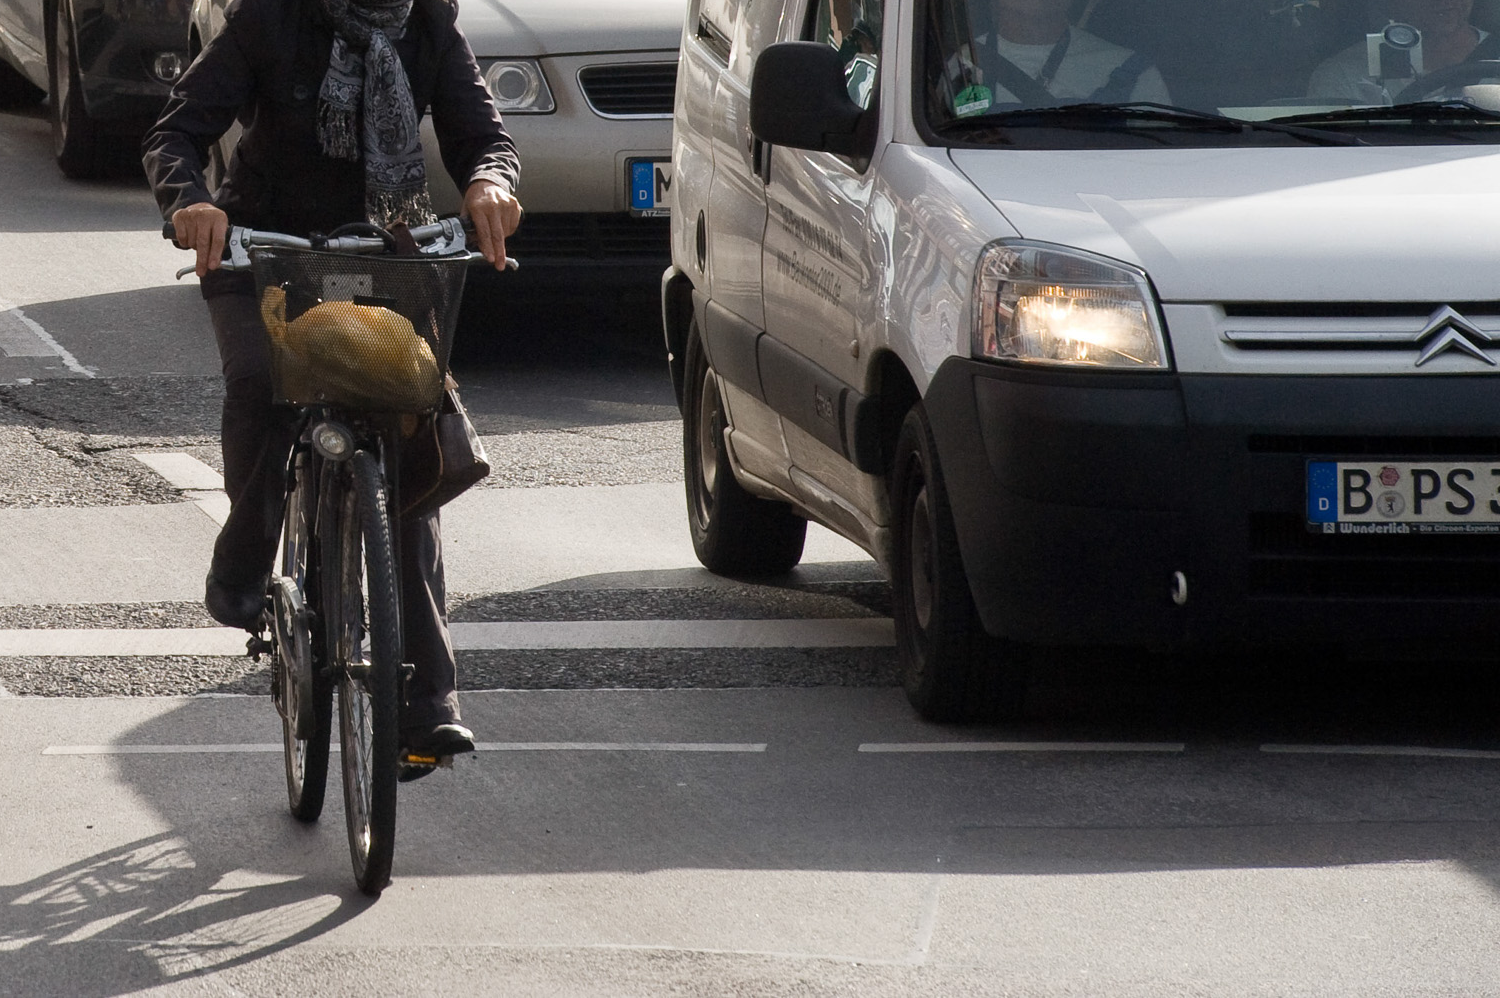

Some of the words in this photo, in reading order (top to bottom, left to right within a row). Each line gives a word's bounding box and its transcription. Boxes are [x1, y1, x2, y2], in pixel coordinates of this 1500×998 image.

[639, 190, 647, 200] D
[1343, 469, 1373, 514] B
[1411, 468, 1475, 515] PS
[1318, 498, 1329, 510] D
[1339, 522, 1410, 533] Wunderlich
